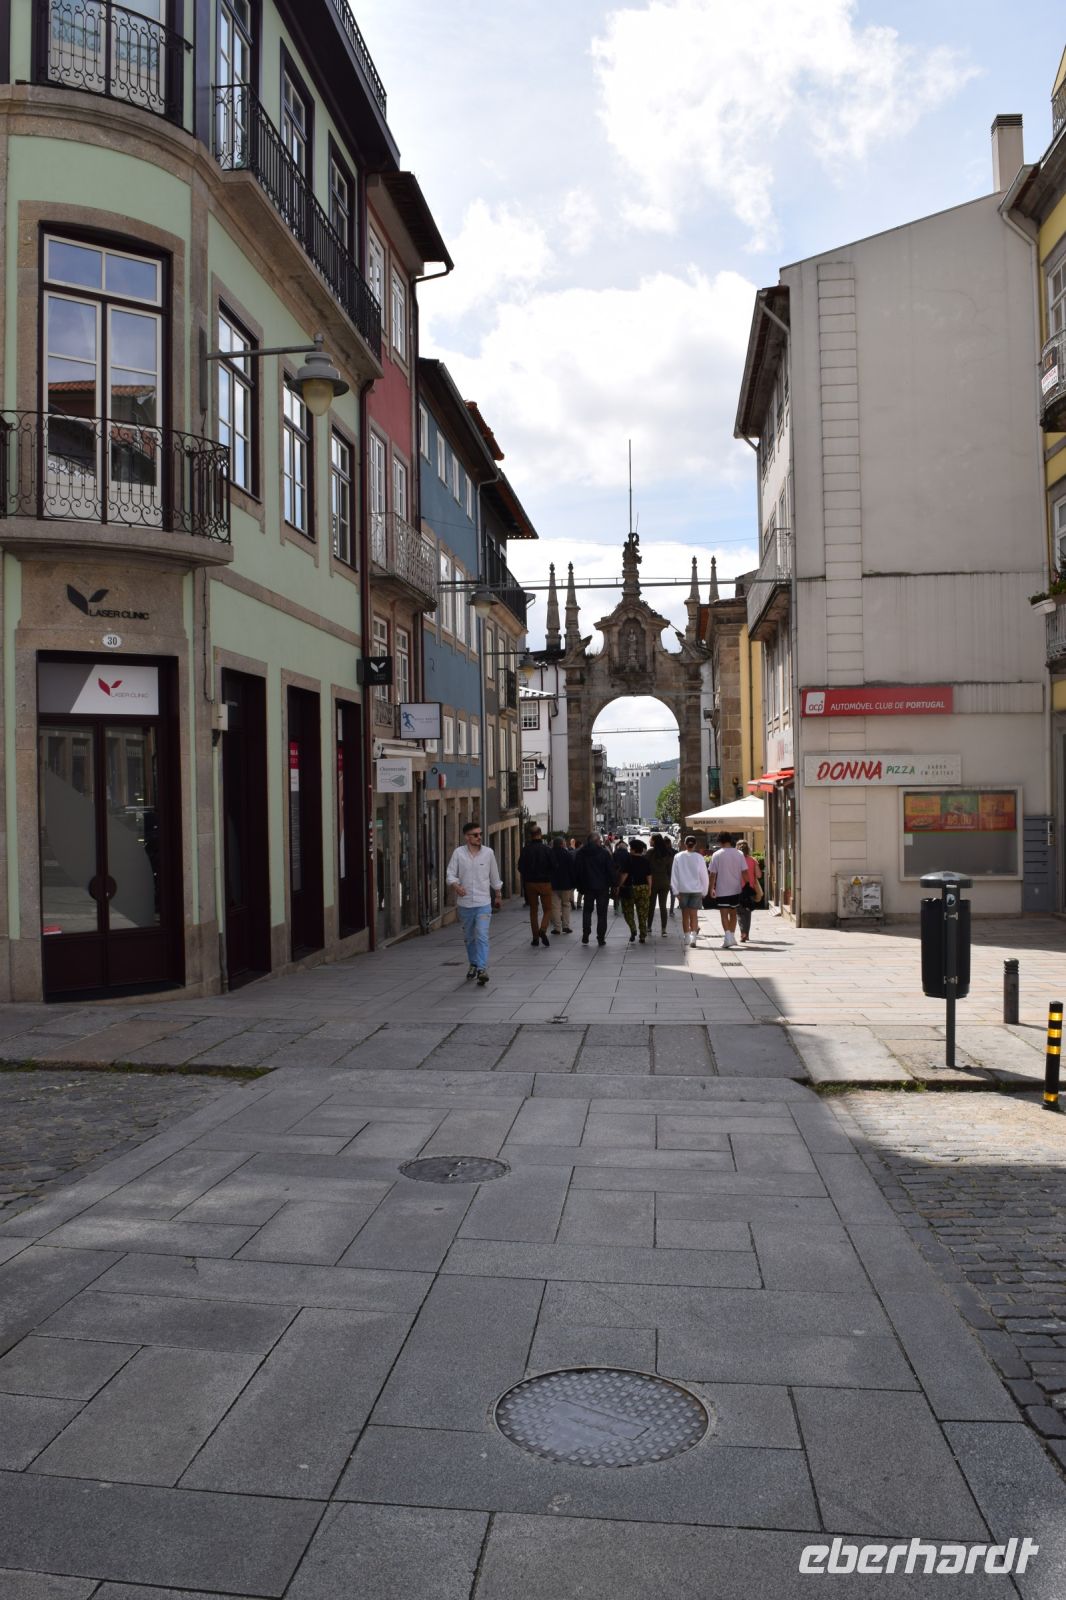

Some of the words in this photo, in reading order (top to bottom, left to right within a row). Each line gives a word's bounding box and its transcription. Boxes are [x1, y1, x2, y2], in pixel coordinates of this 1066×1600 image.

[89, 609, 120, 618] LASER
[121, 610, 150, 620] CLINIC
[107, 636, 117, 646] 30
[808, 703, 823, 712] acp
[830, 702, 874, 711] AUTOMÓVEL
[874, 702, 894, 710] CLUB
[894, 701, 905, 709] DE
[905, 701, 945, 709] PORTUGAL
[817, 760, 882, 780] DONNA
[886, 765, 915, 775] PIZZA
